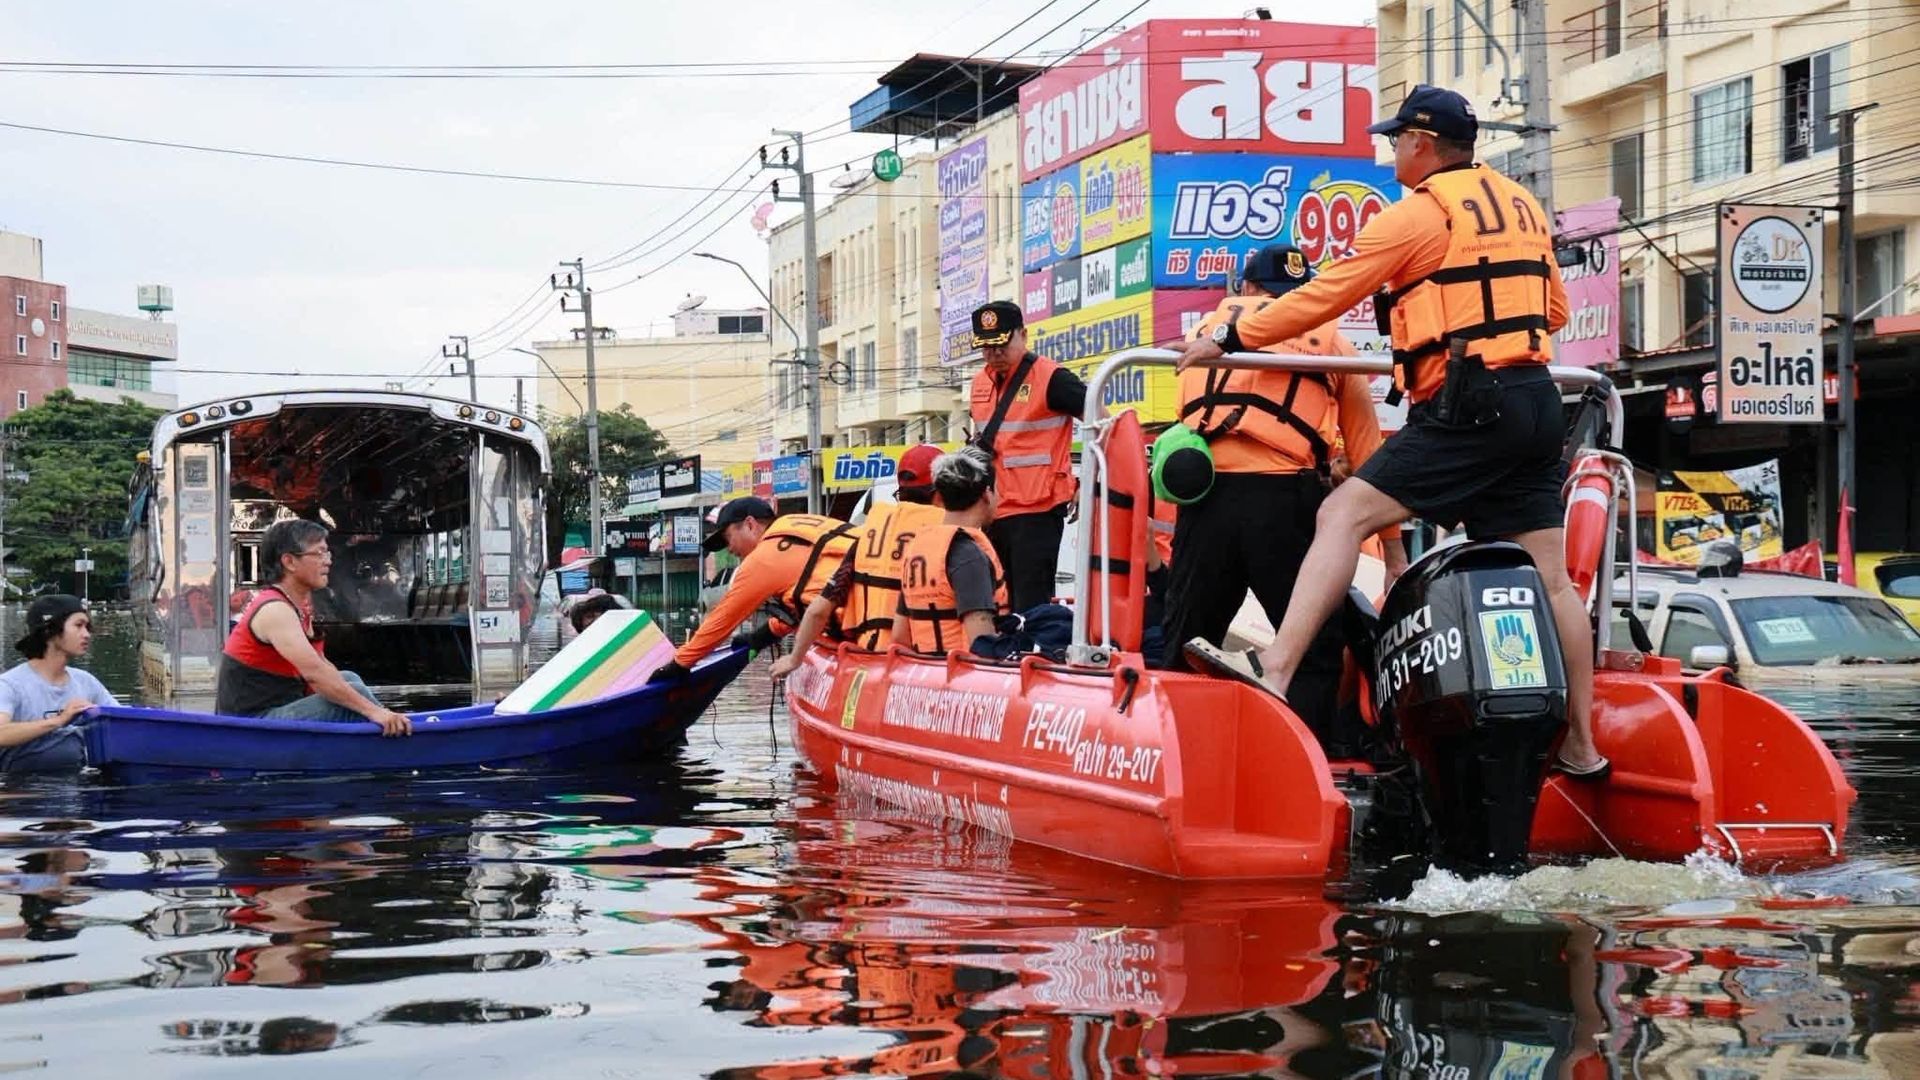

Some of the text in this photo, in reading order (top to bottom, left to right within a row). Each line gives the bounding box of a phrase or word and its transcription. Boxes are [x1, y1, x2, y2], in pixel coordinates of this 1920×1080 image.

[1023, 47, 1142, 172] สยามชัย
[1171, 166, 1292, 239] แอร์
[1197, 247, 1237, 281] ตู้เย็น
[1741, 268, 1806, 281] motorbike
[1730, 342, 1814, 387] อะไหล่
[834, 451, 895, 480] มือถือ
[1482, 587, 1535, 607] 60
[1393, 626, 1462, 692] 31-209
[1022, 702, 1086, 757] PE440
[1106, 743, 1163, 785] 29-207
